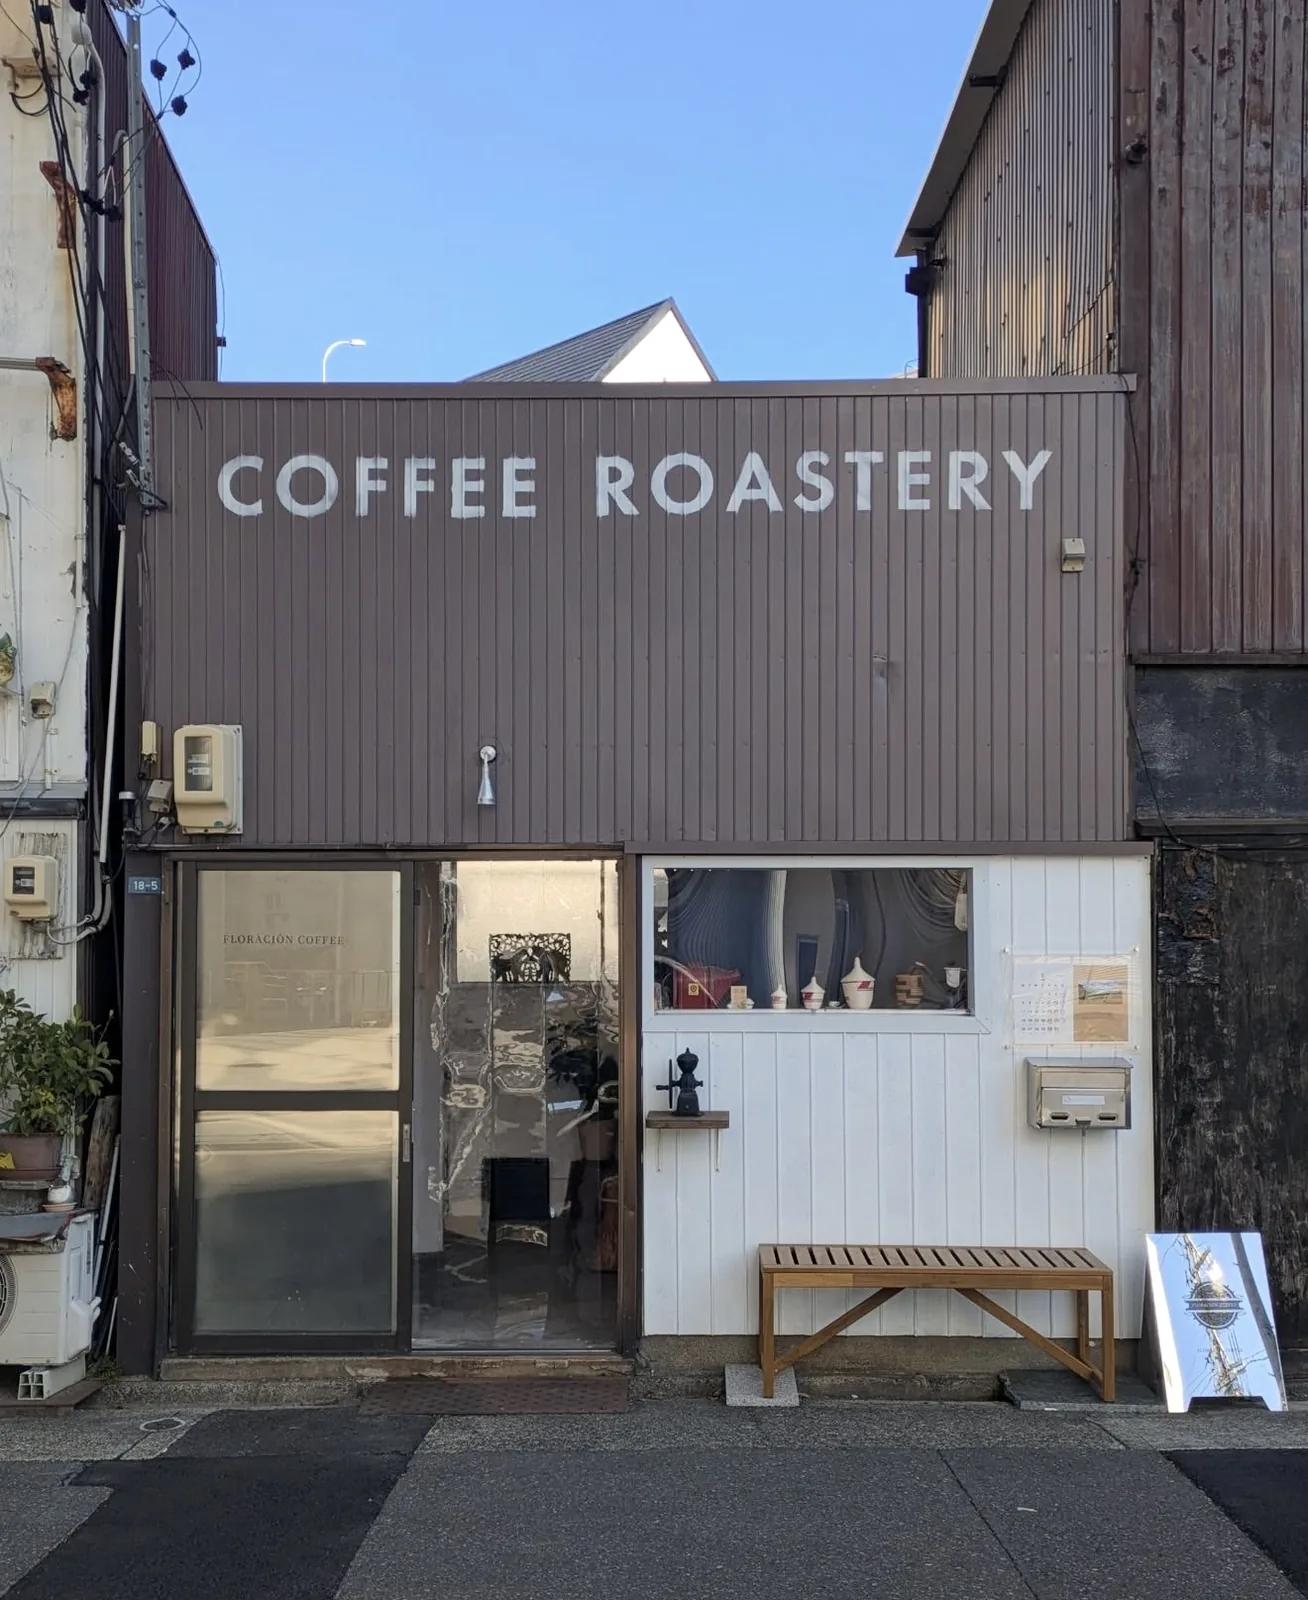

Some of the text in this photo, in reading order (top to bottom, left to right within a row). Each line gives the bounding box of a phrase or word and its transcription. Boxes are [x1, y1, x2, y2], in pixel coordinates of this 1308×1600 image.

[217, 450, 1054, 519] COFFEE ROASTERY
[133, 880, 158, 891] 18-5
[297, 935, 344, 945] COFFEE
